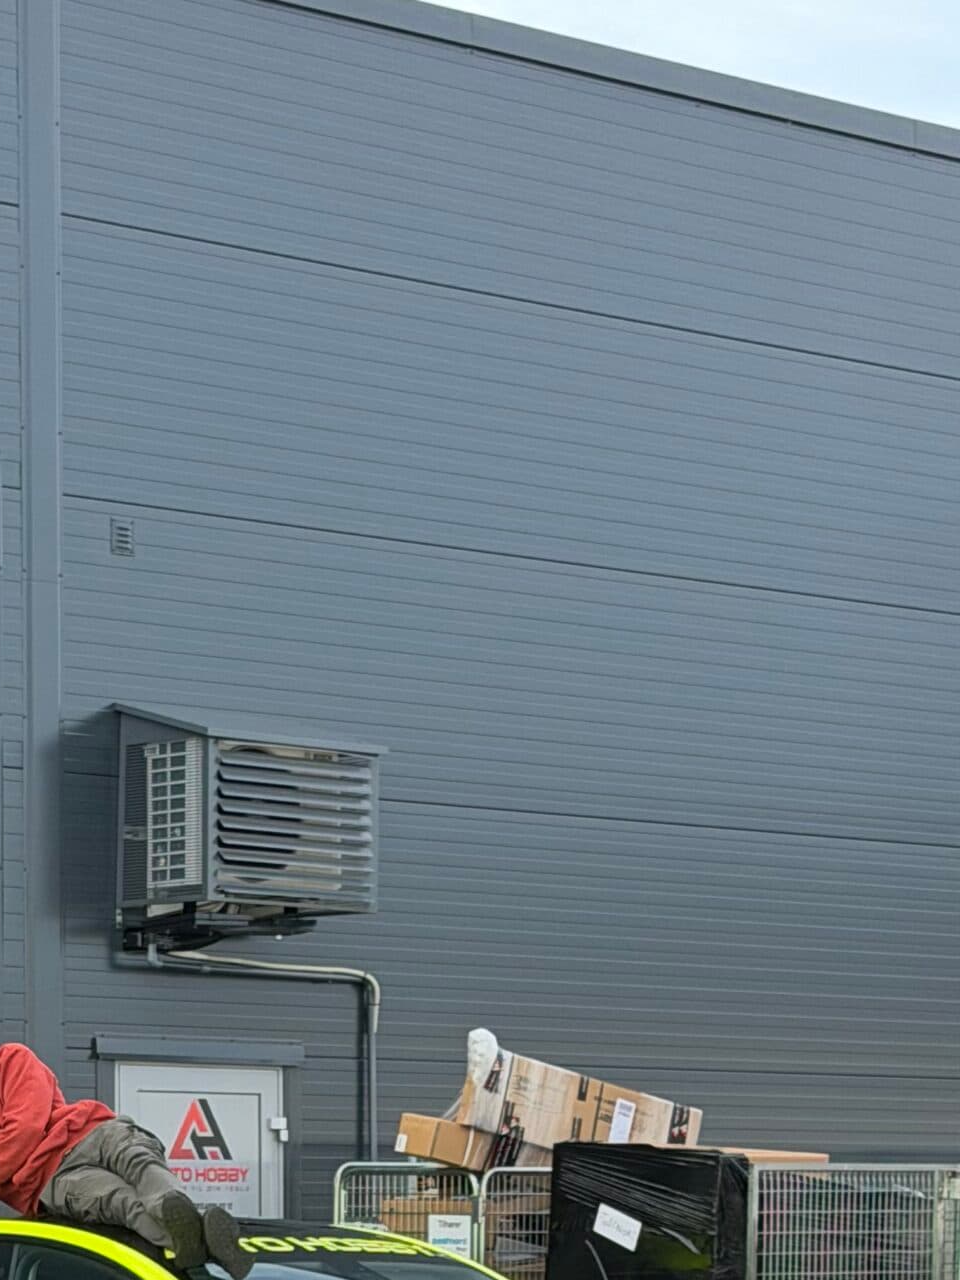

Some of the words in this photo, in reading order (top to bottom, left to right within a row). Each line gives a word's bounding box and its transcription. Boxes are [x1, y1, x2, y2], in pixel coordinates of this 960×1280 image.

[168, 1167, 192, 1182] TO
[195, 1167, 249, 1183] HOBBY
[238, 1237, 295, 1253] TO
